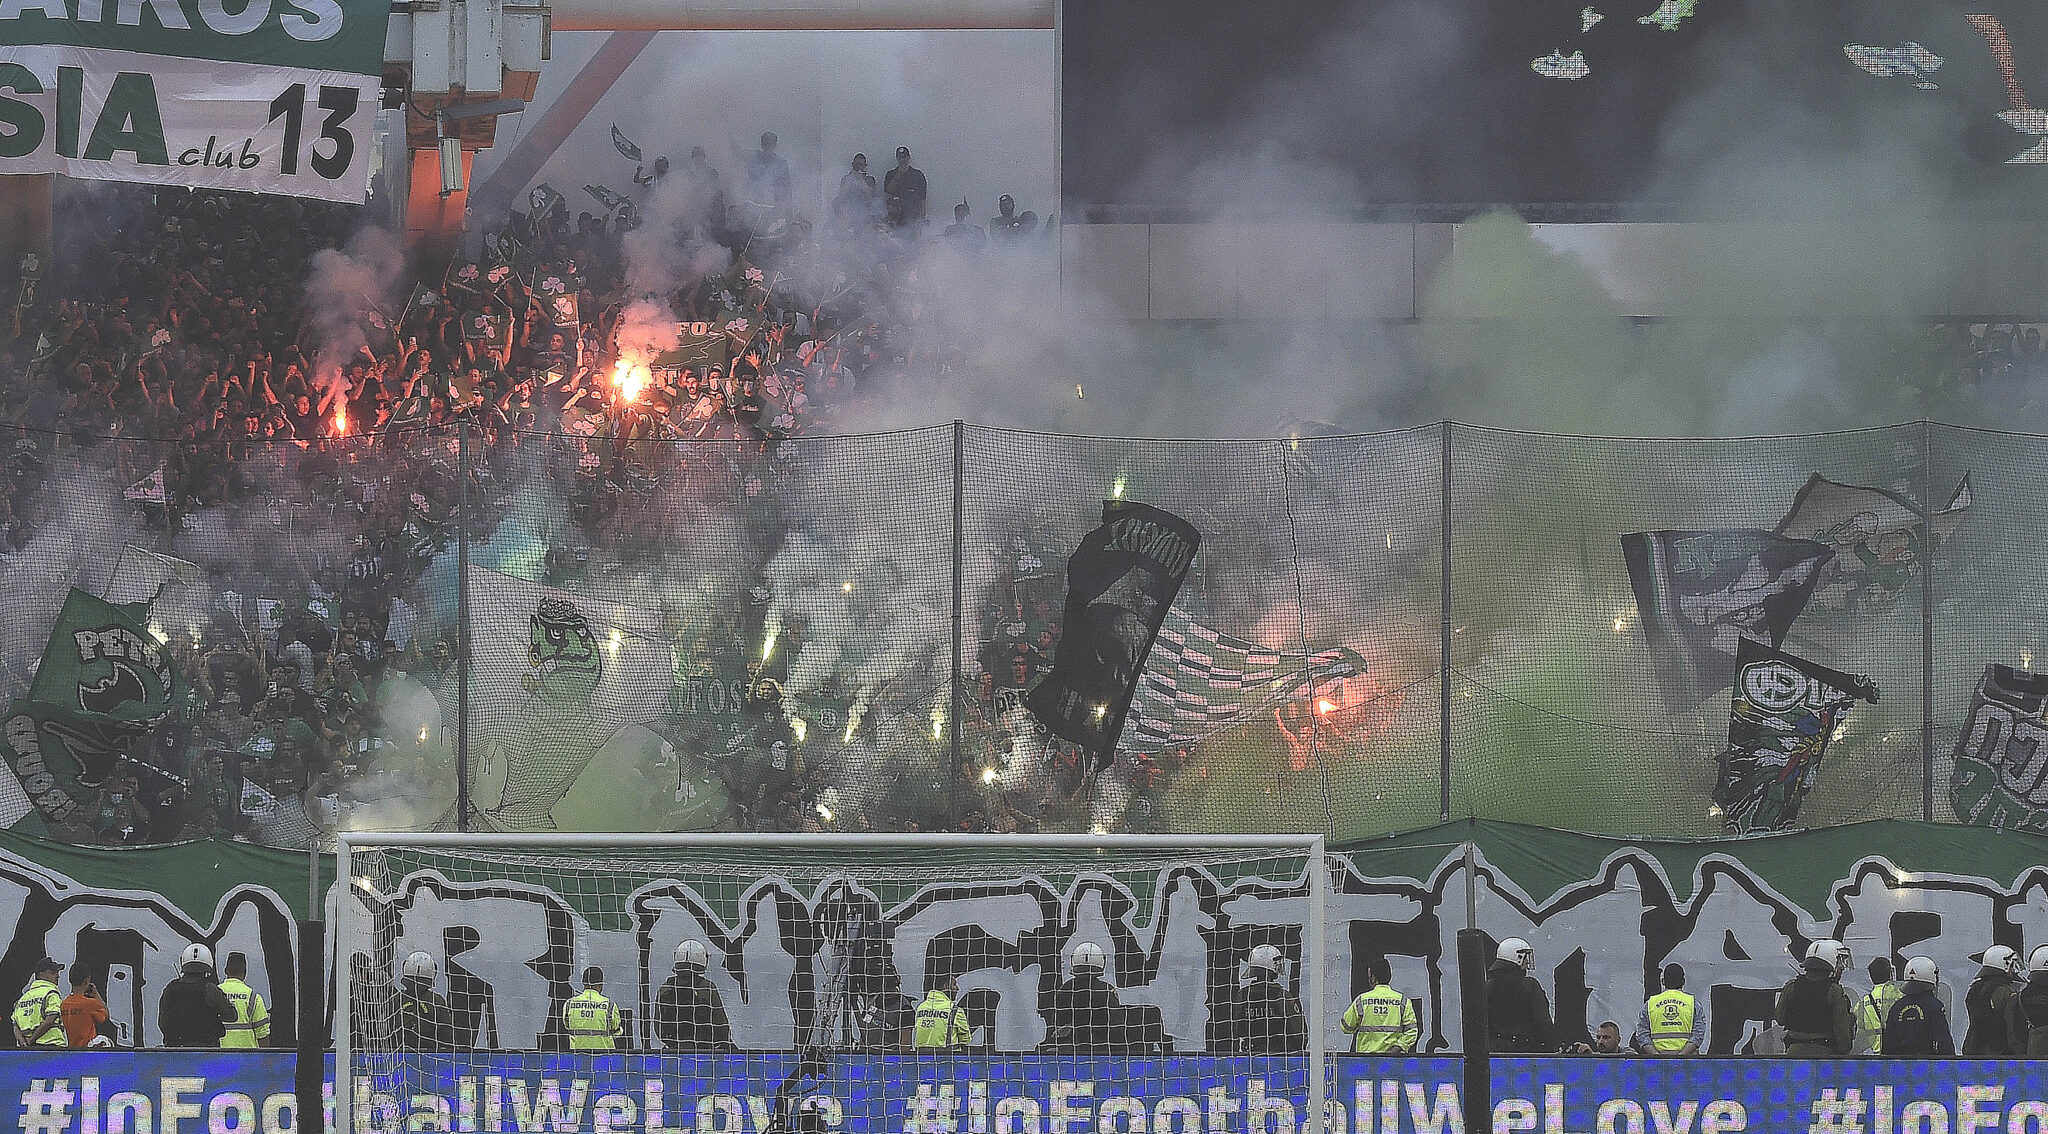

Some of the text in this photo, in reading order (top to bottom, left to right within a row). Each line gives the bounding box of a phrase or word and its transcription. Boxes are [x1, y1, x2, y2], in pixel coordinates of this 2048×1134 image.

[178, 135, 260, 169] club
[268, 82, 359, 180] 13
[576, 1002, 607, 1010] BRINKS
[1368, 998, 1401, 1006] BRINKS
[580, 1010, 594, 1018] 501
[1373, 1006, 1388, 1015] 512
[921, 1020, 935, 1028] 523
